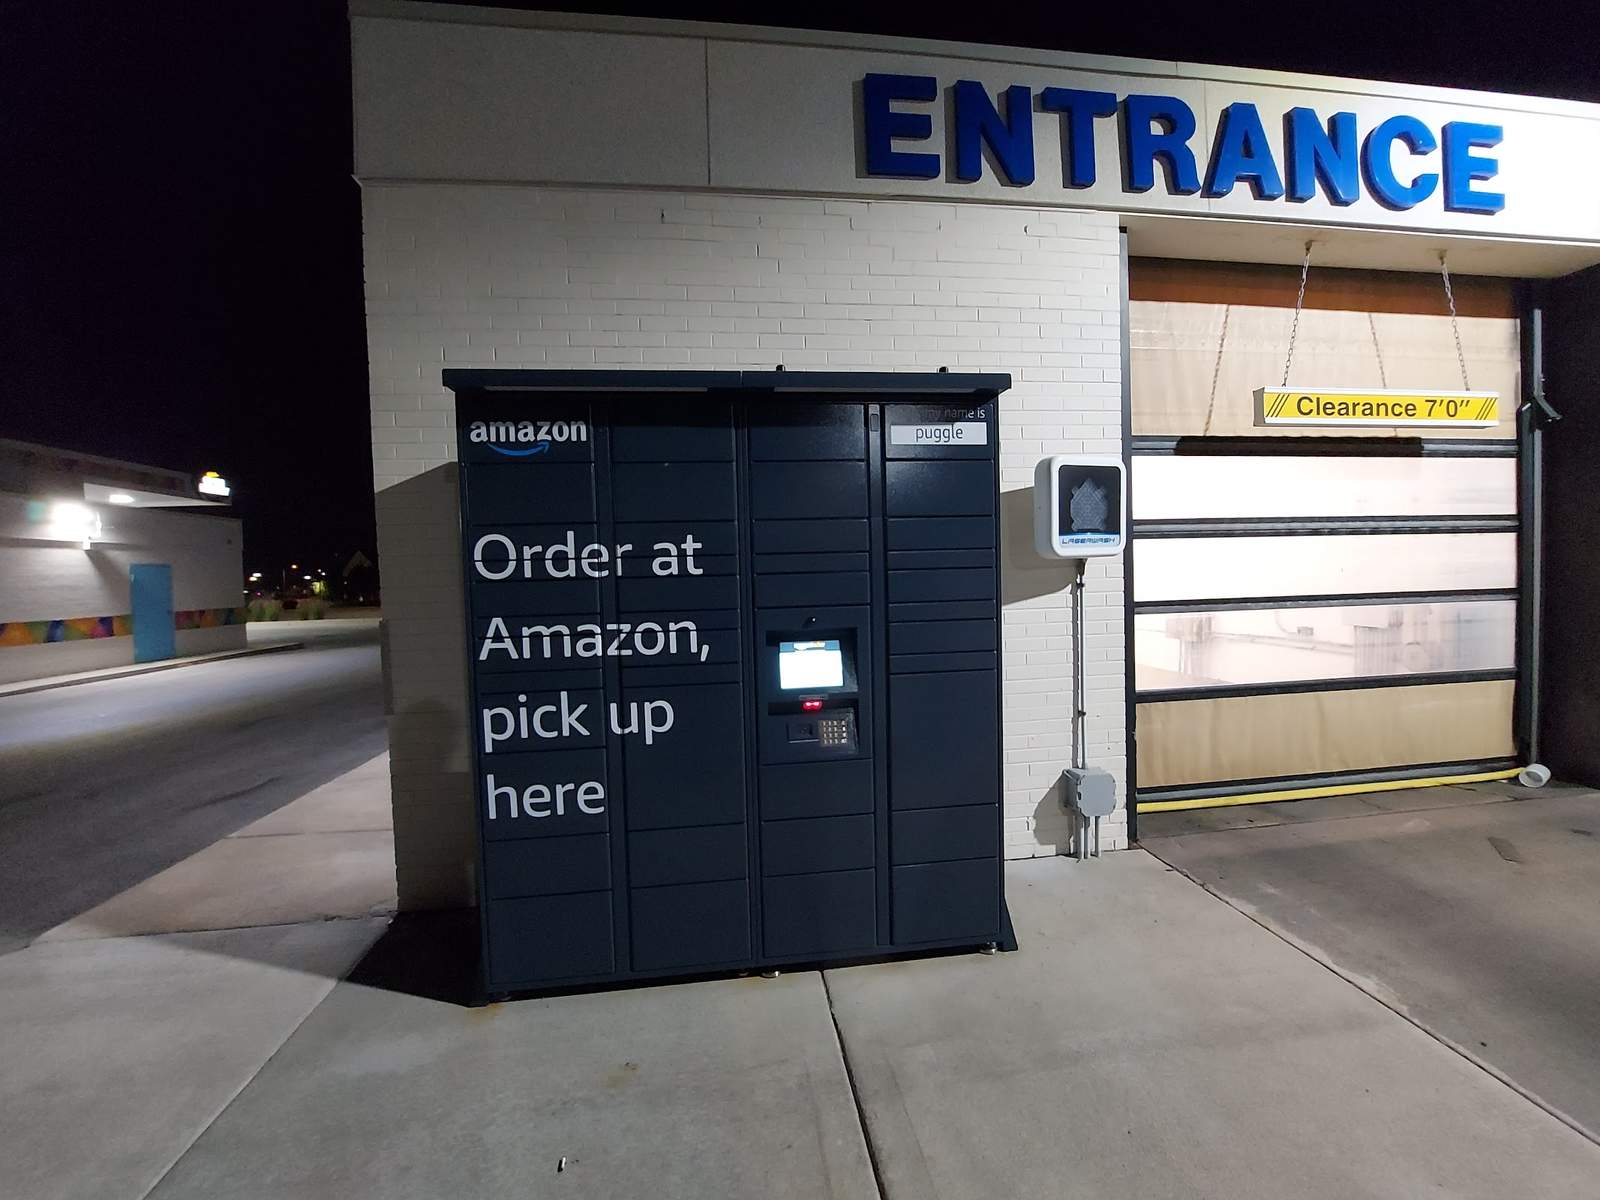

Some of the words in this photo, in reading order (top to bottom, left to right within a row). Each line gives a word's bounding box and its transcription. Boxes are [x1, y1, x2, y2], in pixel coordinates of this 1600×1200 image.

[862, 73, 1505, 215] ENTRANCE
[977, 407, 986, 419] is
[1296, 396, 1417, 417] Clearance
[1425, 399, 1470, 418] 7'0"
[469, 420, 587, 443] amazon
[915, 424, 964, 443] puggle
[473, 531, 632, 580] Order
[651, 534, 704, 576] at
[479, 617, 710, 662] Amazon,
[482, 691, 590, 753] pick
[609, 699, 675, 745] up
[486, 773, 606, 819] here
